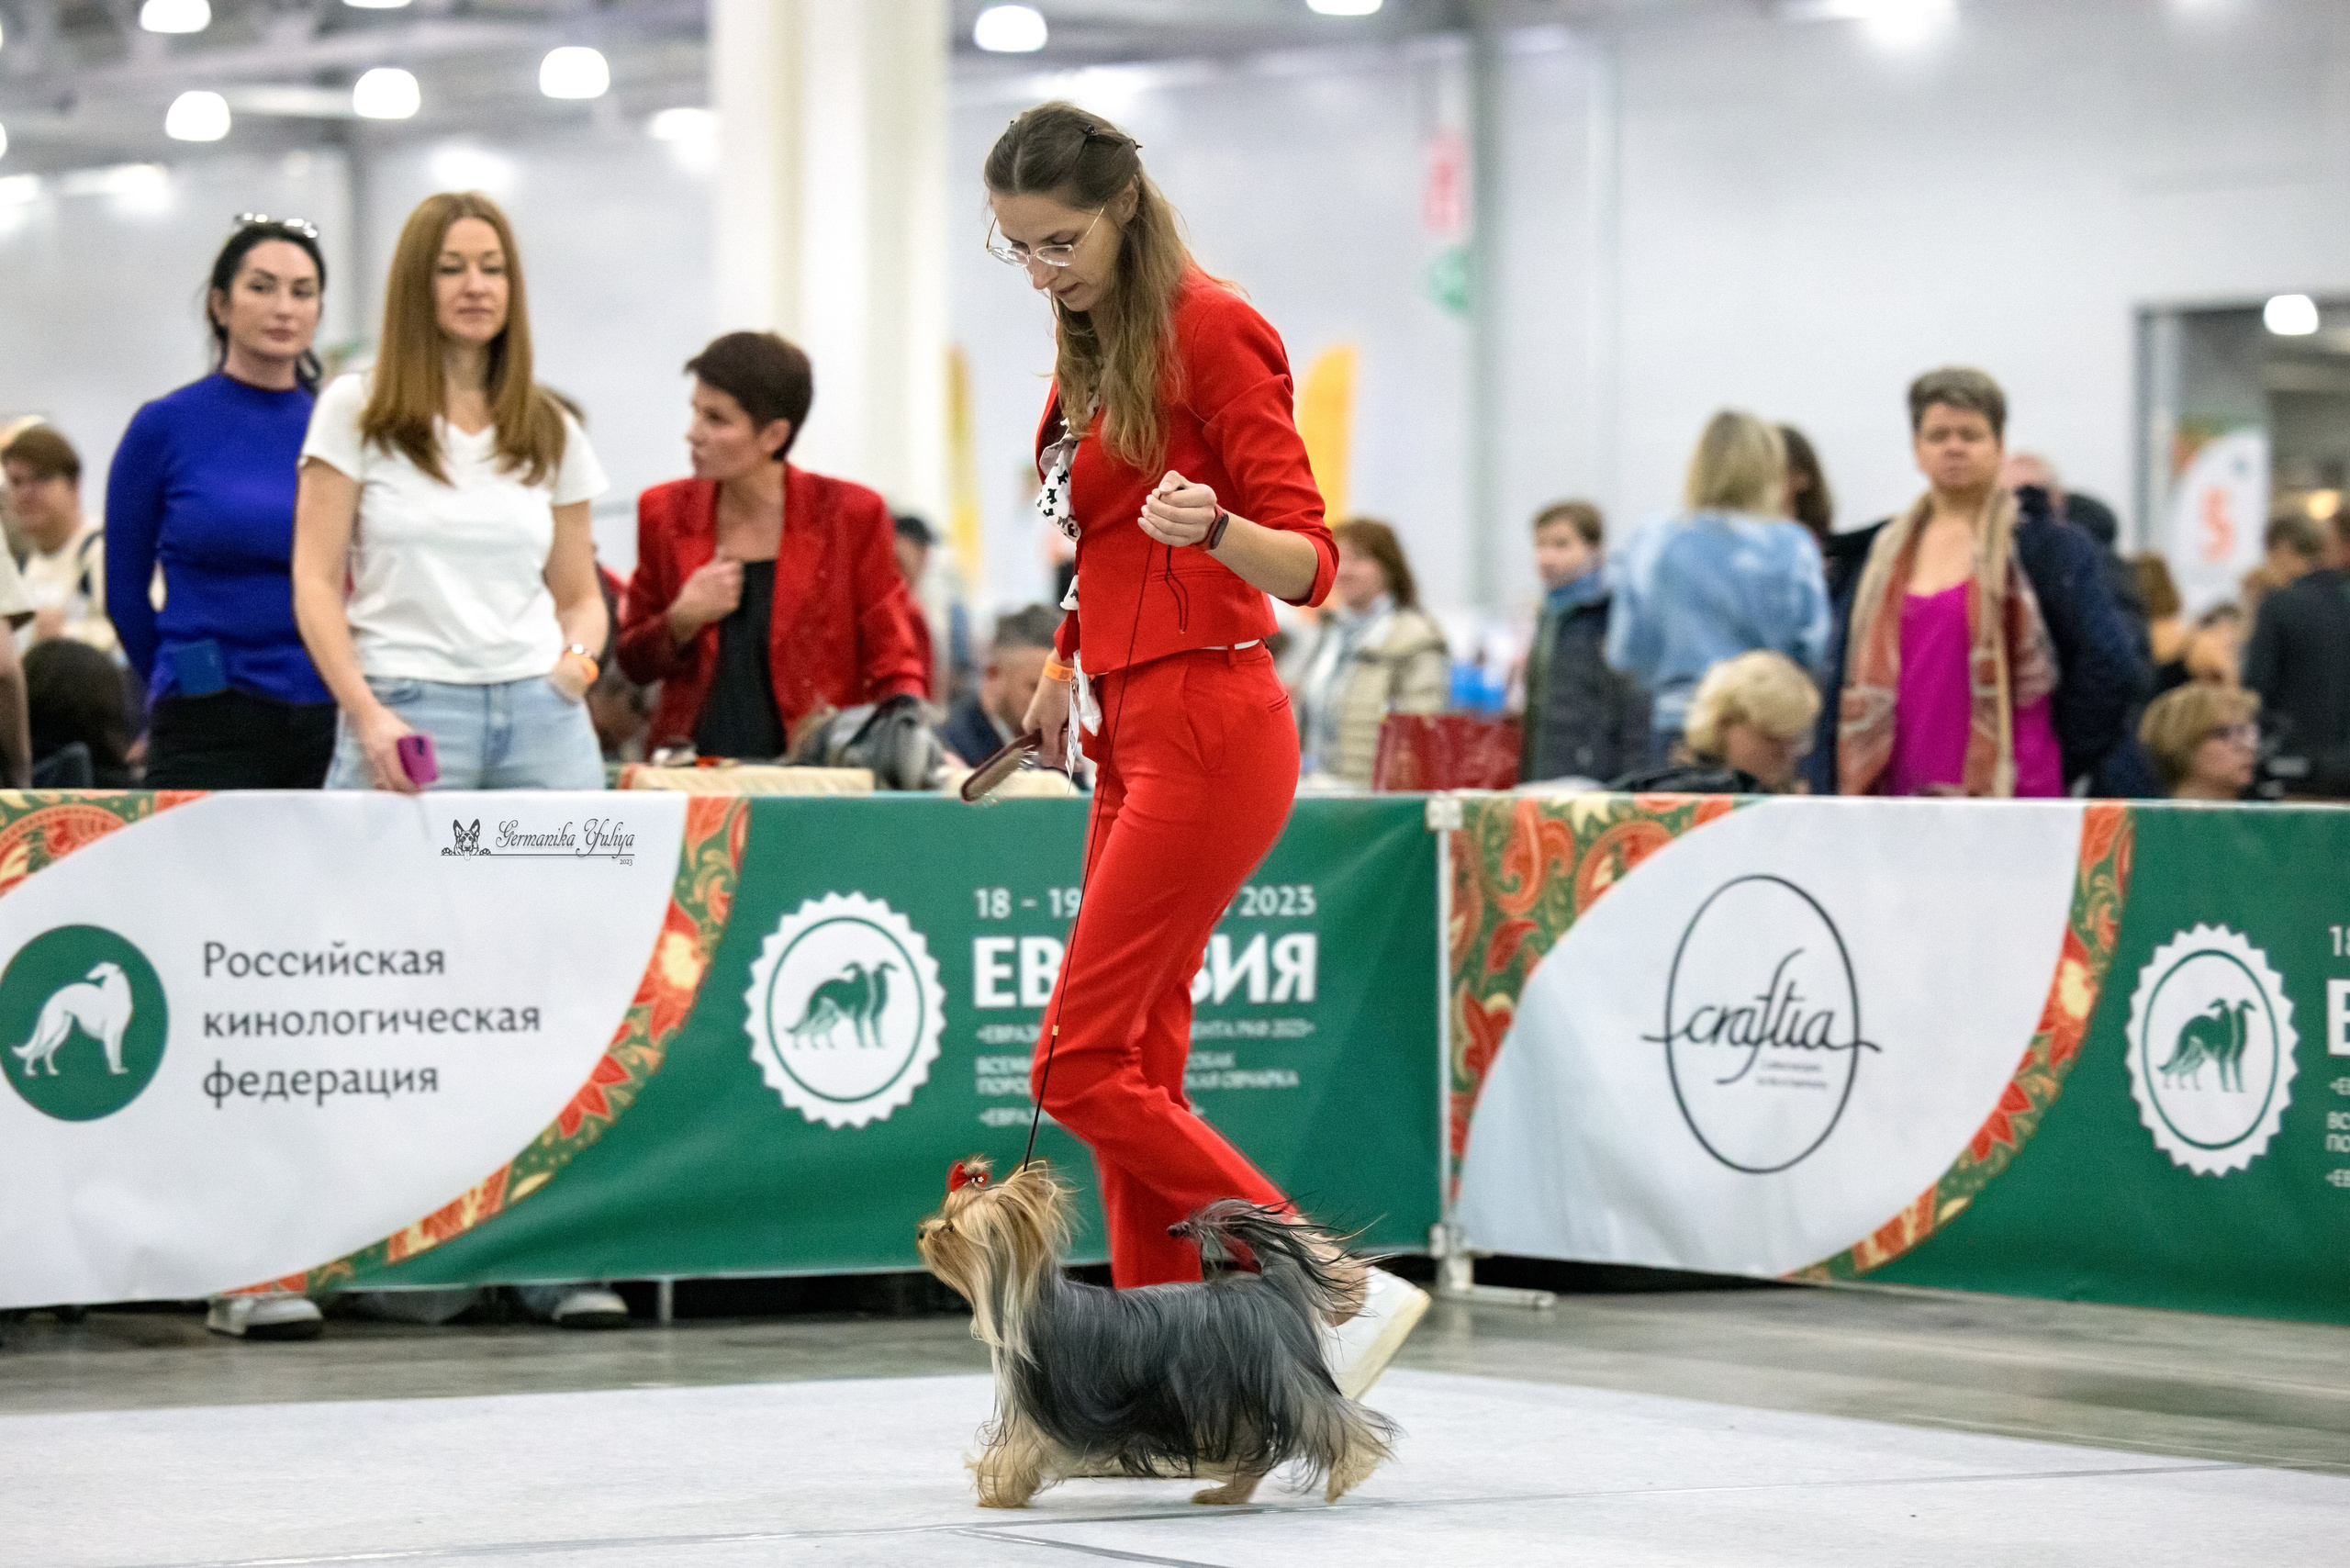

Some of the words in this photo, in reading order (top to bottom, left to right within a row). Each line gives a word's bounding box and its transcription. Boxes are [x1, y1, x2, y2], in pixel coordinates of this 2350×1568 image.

[976, 887, 1011, 919] 18
[1049, 887, 1082, 918] 19
[1240, 884, 1317, 916] 2023
[2329, 925, 2350, 956] 1
[203, 940, 445, 978] Российская
[203, 1006, 542, 1037] кинологическая
[203, 1058, 440, 1109] федерация
